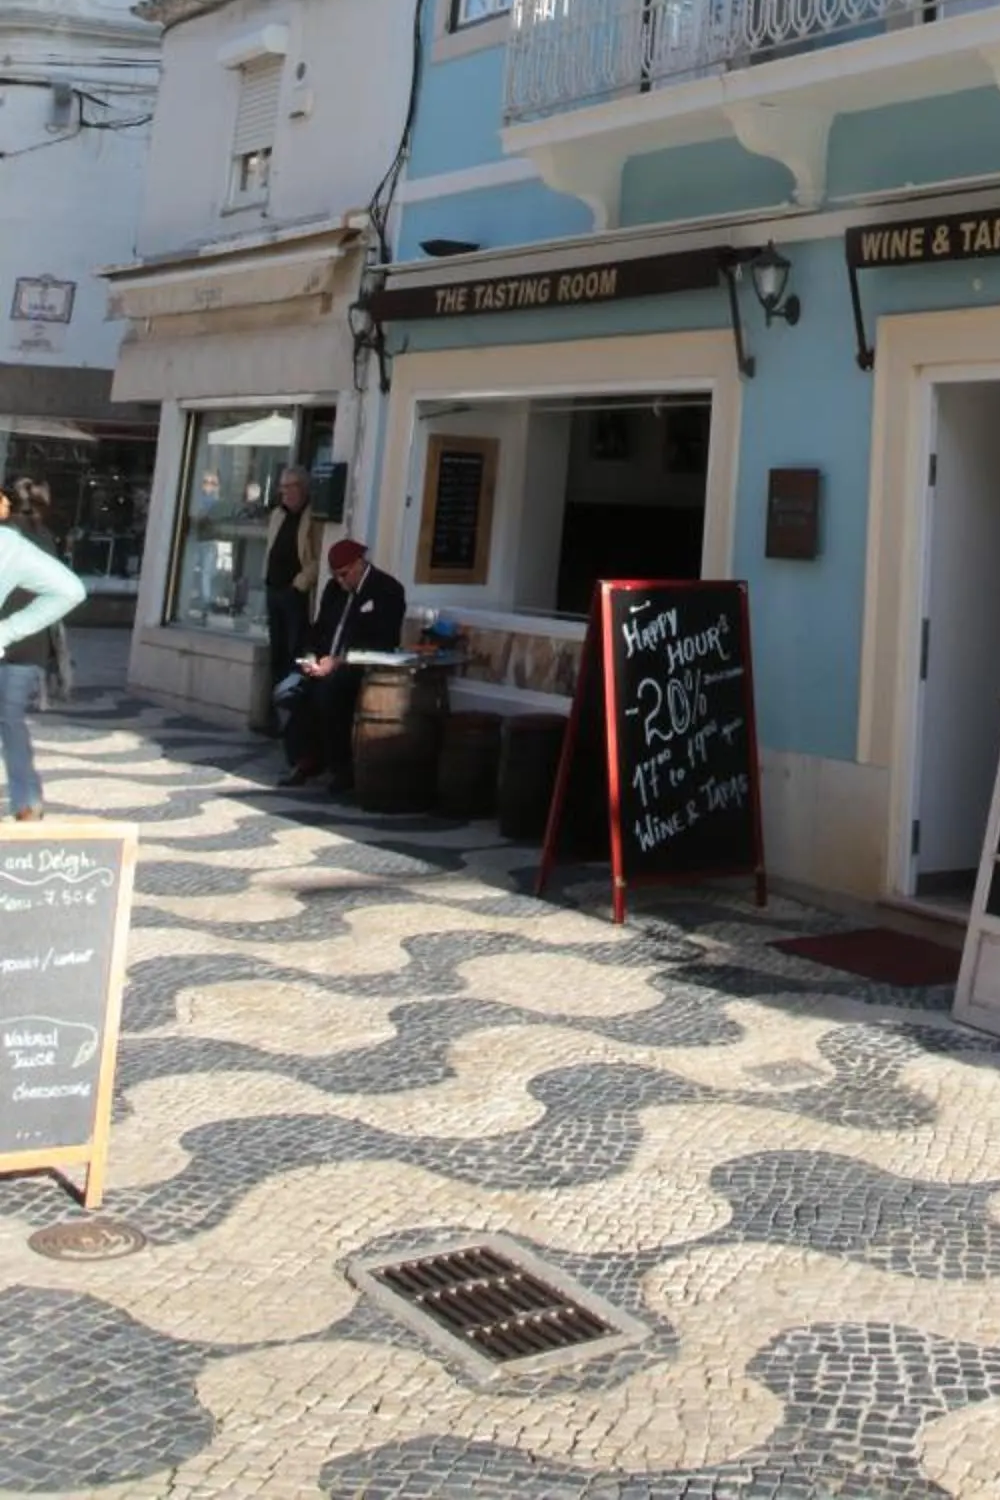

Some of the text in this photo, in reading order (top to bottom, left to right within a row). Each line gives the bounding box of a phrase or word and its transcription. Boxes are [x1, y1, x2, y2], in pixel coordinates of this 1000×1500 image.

[861, 227, 925, 261] WINE
[931, 224, 950, 255] &
[434, 268, 618, 314] THE TASTING ROOM
[5, 852, 34, 869] and
